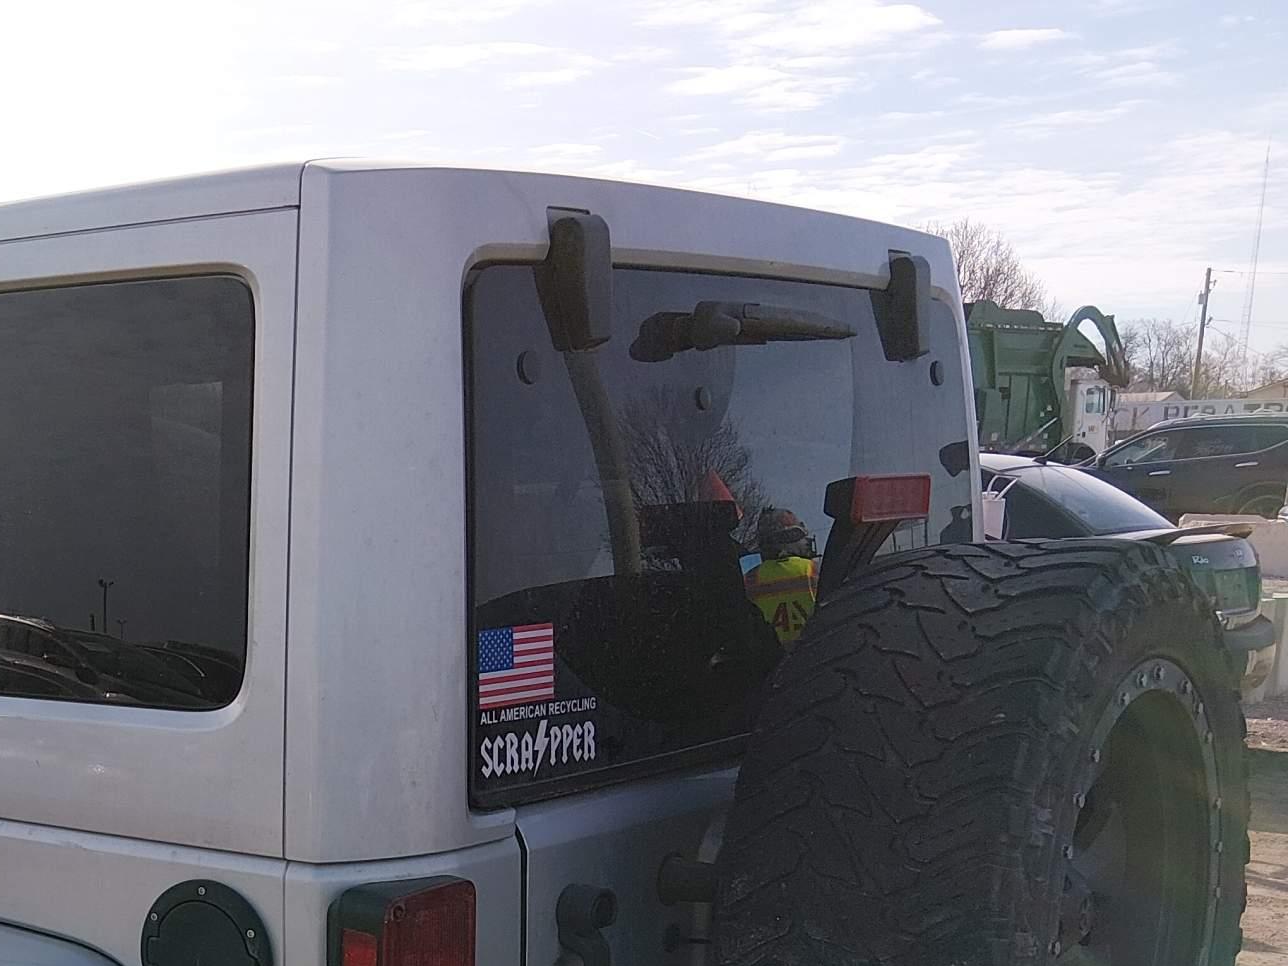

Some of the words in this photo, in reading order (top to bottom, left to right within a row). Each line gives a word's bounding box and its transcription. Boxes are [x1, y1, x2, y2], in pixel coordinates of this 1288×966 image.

[1192, 555, 1209, 564] Rio
[480, 709, 499, 726] ALL
[500, 703, 547, 722] AMERICAN
[548, 697, 597, 716] RECYCLING
